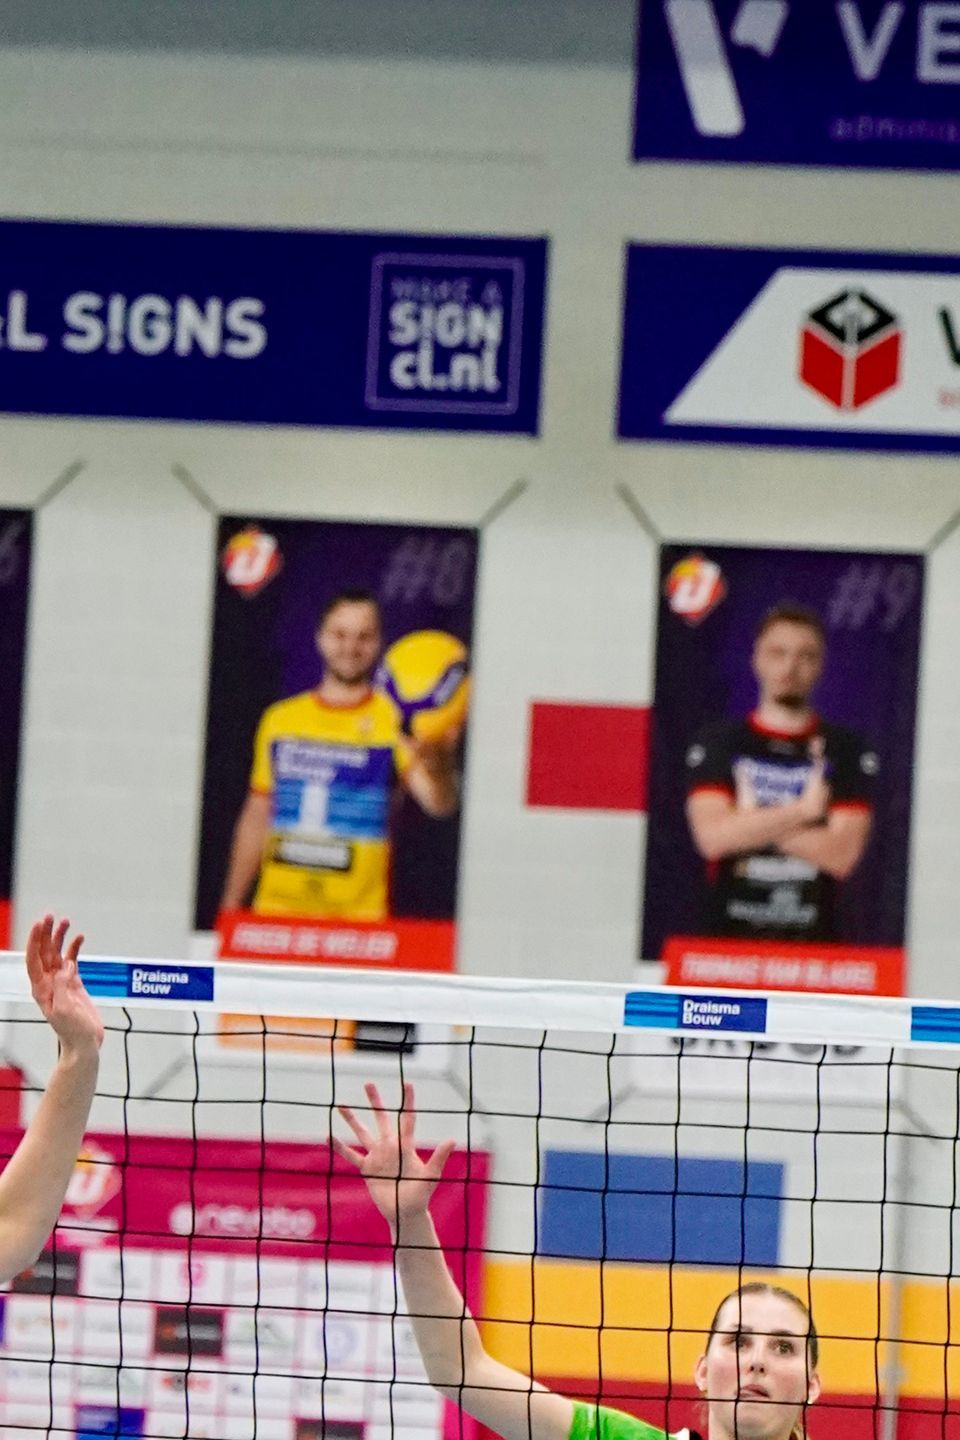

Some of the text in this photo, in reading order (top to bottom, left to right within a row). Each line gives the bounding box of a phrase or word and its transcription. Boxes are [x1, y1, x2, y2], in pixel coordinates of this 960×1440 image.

[132, 969, 189, 984] Draisma
[131, 982, 171, 995] Bouw
[682, 999, 740, 1015] Draisma
[682, 1012, 722, 1026] Bouw
